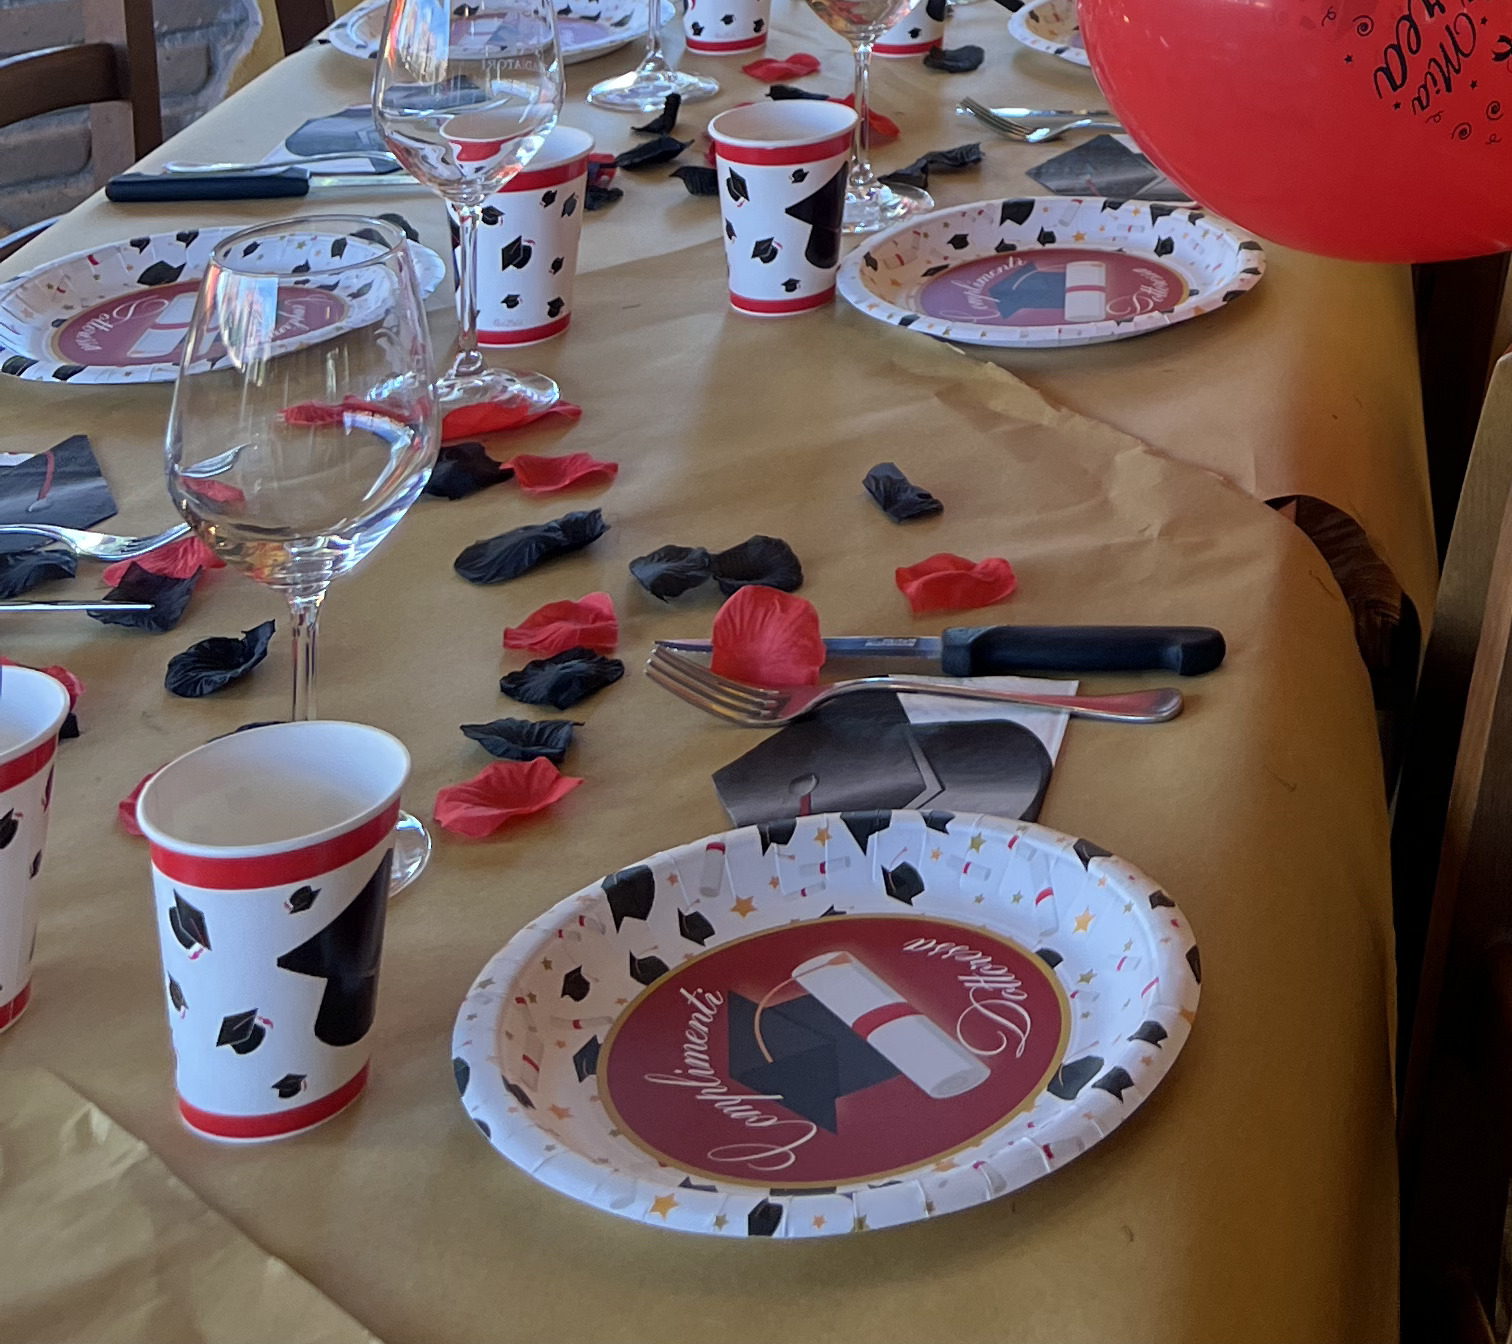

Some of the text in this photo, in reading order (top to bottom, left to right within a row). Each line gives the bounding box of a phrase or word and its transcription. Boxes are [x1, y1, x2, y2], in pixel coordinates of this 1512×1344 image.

[1411, 12, 1477, 115] Mia
[902, 936, 1031, 1059] Dottoressa
[644, 986, 818, 1170] Complimenti
